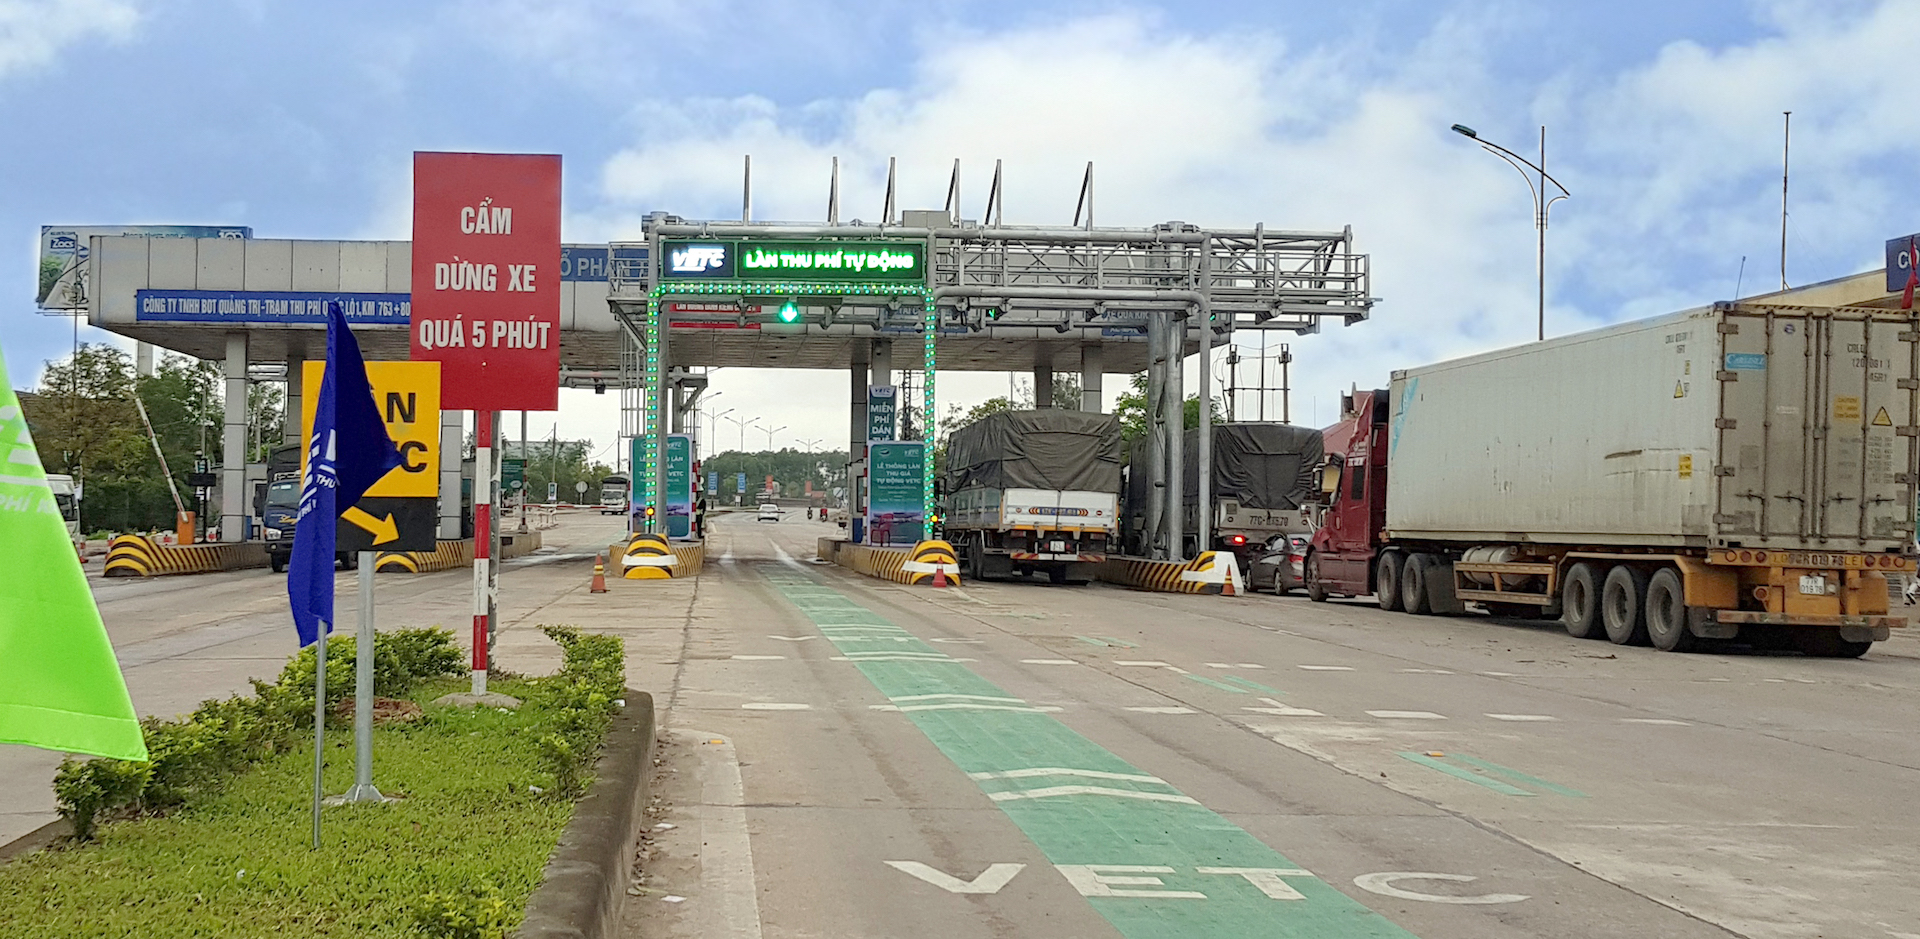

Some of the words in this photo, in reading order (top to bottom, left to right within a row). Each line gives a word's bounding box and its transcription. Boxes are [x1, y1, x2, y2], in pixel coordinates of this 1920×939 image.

[52, 238, 74, 248] Zacs
[673, 248, 726, 272] VETC
[745, 250, 779, 268] LÀN
[780, 254, 812, 268] THU
[814, 250, 843, 268] PHÍ
[843, 253, 867, 272] TỰ
[867, 250, 914, 272] ĐỘNG
[435, 255, 497, 291] DỪNG
[507, 265, 536, 292] XE
[143, 295, 166, 313] CÔNG
[167, 299, 177, 313] TY
[179, 299, 200, 313] TNHH
[201, 299, 217, 314] BOT
[218, 294, 246, 316] QUẢNG
[290, 301, 305, 315] THU
[307, 297, 321, 315] PHÍ
[419, 314, 465, 350] QUÁ
[472, 320, 486, 348] 5
[492, 315, 551, 350] PHÚT
[872, 425, 891, 434] DÁN
[875, 414, 890, 423] PHÍ
[316, 474, 337, 489] THU
